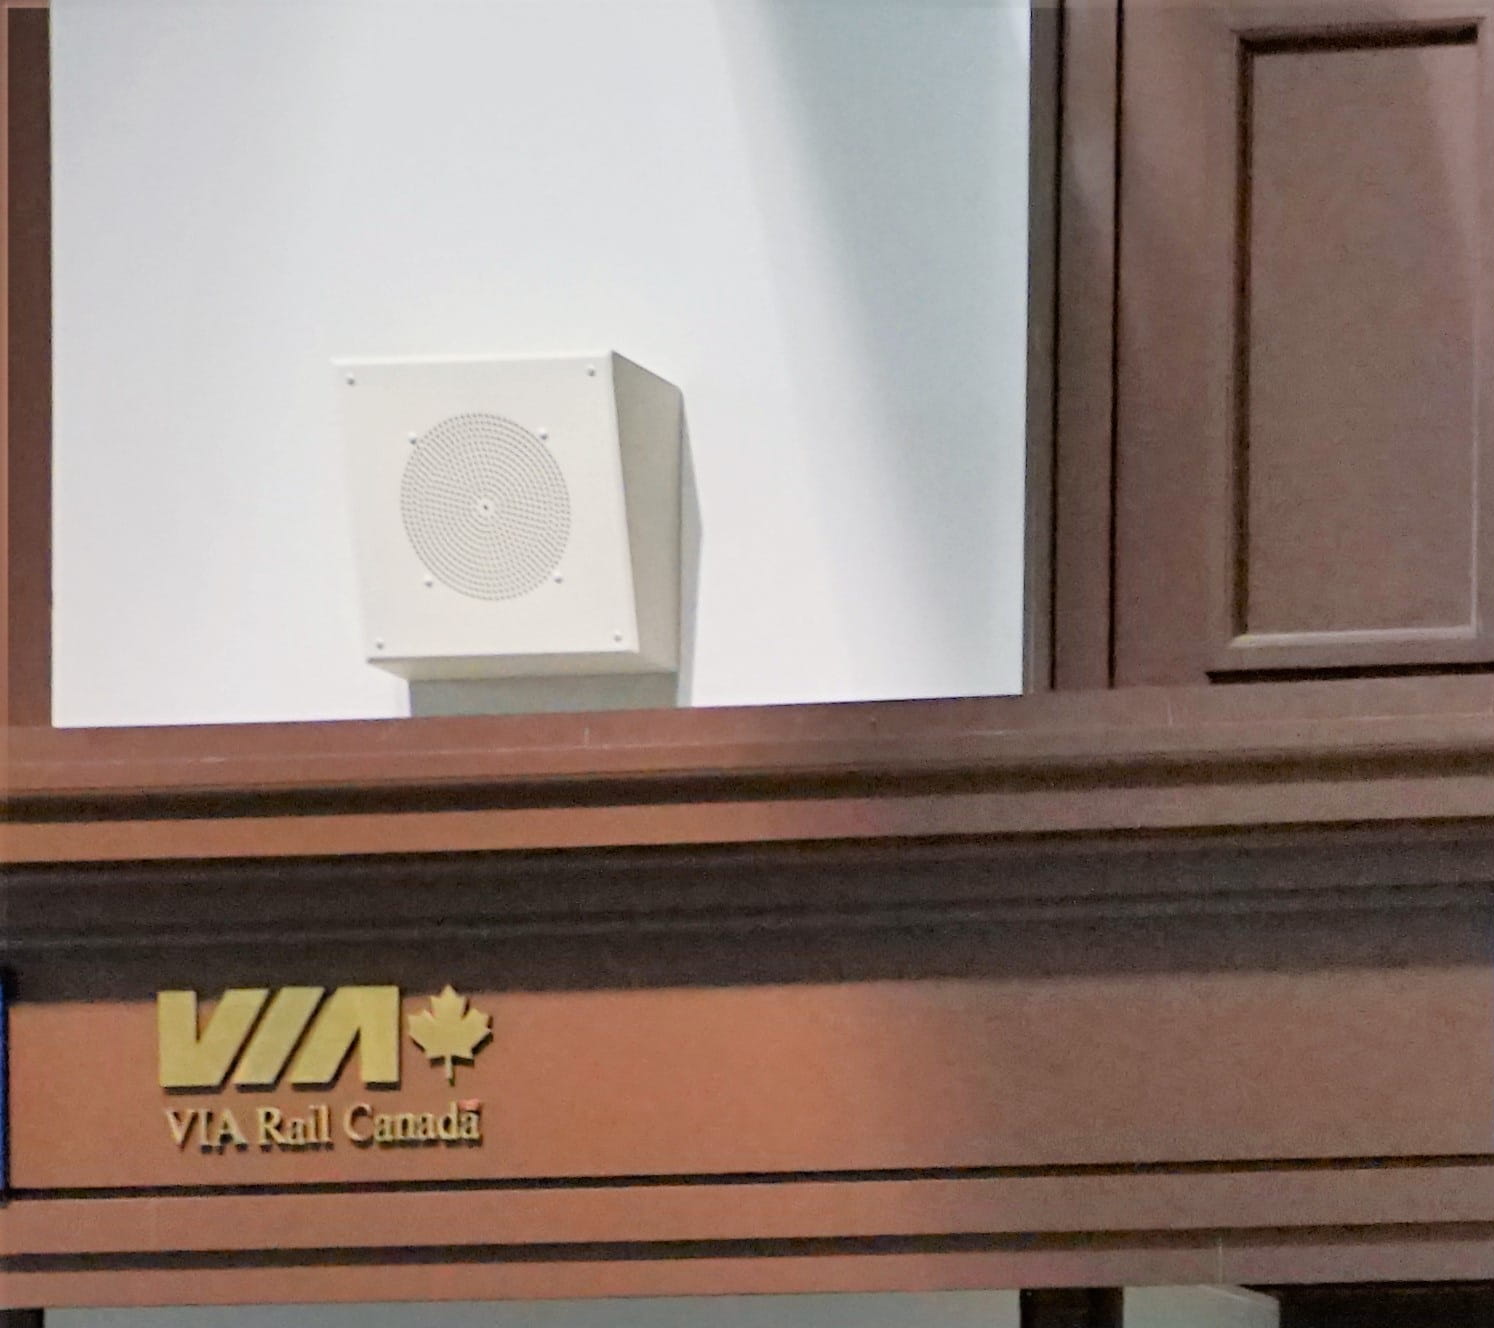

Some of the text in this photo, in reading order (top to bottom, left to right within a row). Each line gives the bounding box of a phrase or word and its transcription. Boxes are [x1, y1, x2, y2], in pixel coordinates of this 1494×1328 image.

[157, 985, 400, 1088] VIA
[166, 1101, 482, 1149] VIA Rail Canada
